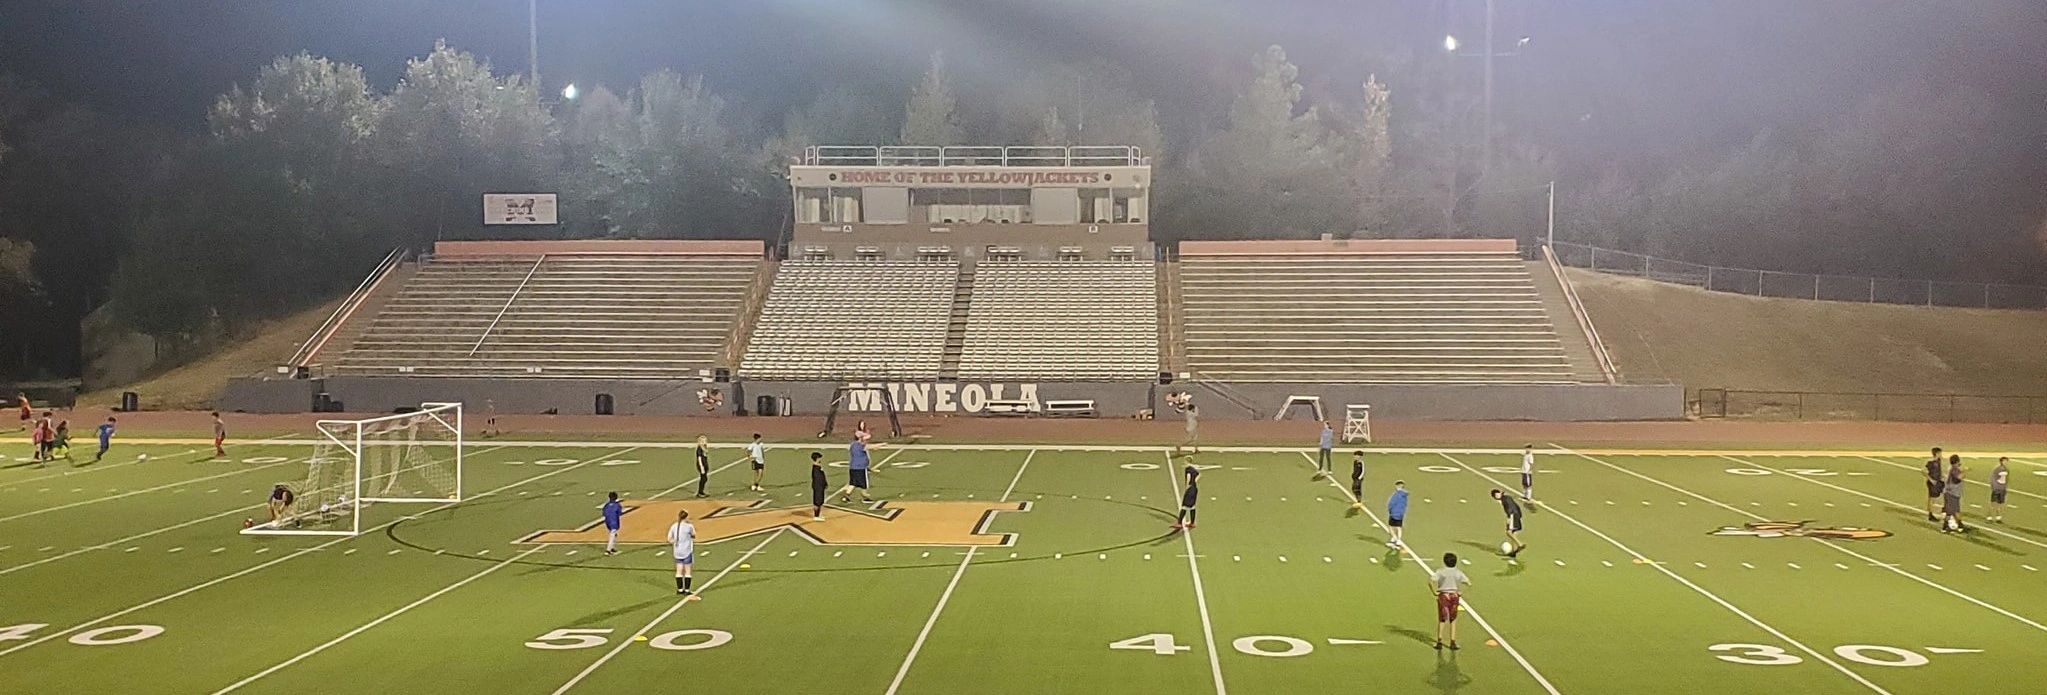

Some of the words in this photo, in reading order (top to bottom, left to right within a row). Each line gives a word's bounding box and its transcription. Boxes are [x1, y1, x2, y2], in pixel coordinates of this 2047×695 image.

[841, 172, 891, 183] HOME
[894, 172, 915, 183] OF
[919, 172, 953, 183] THE
[957, 172, 1099, 184] YELLOWJACKETS
[848, 382, 1041, 413] MINEOLA
